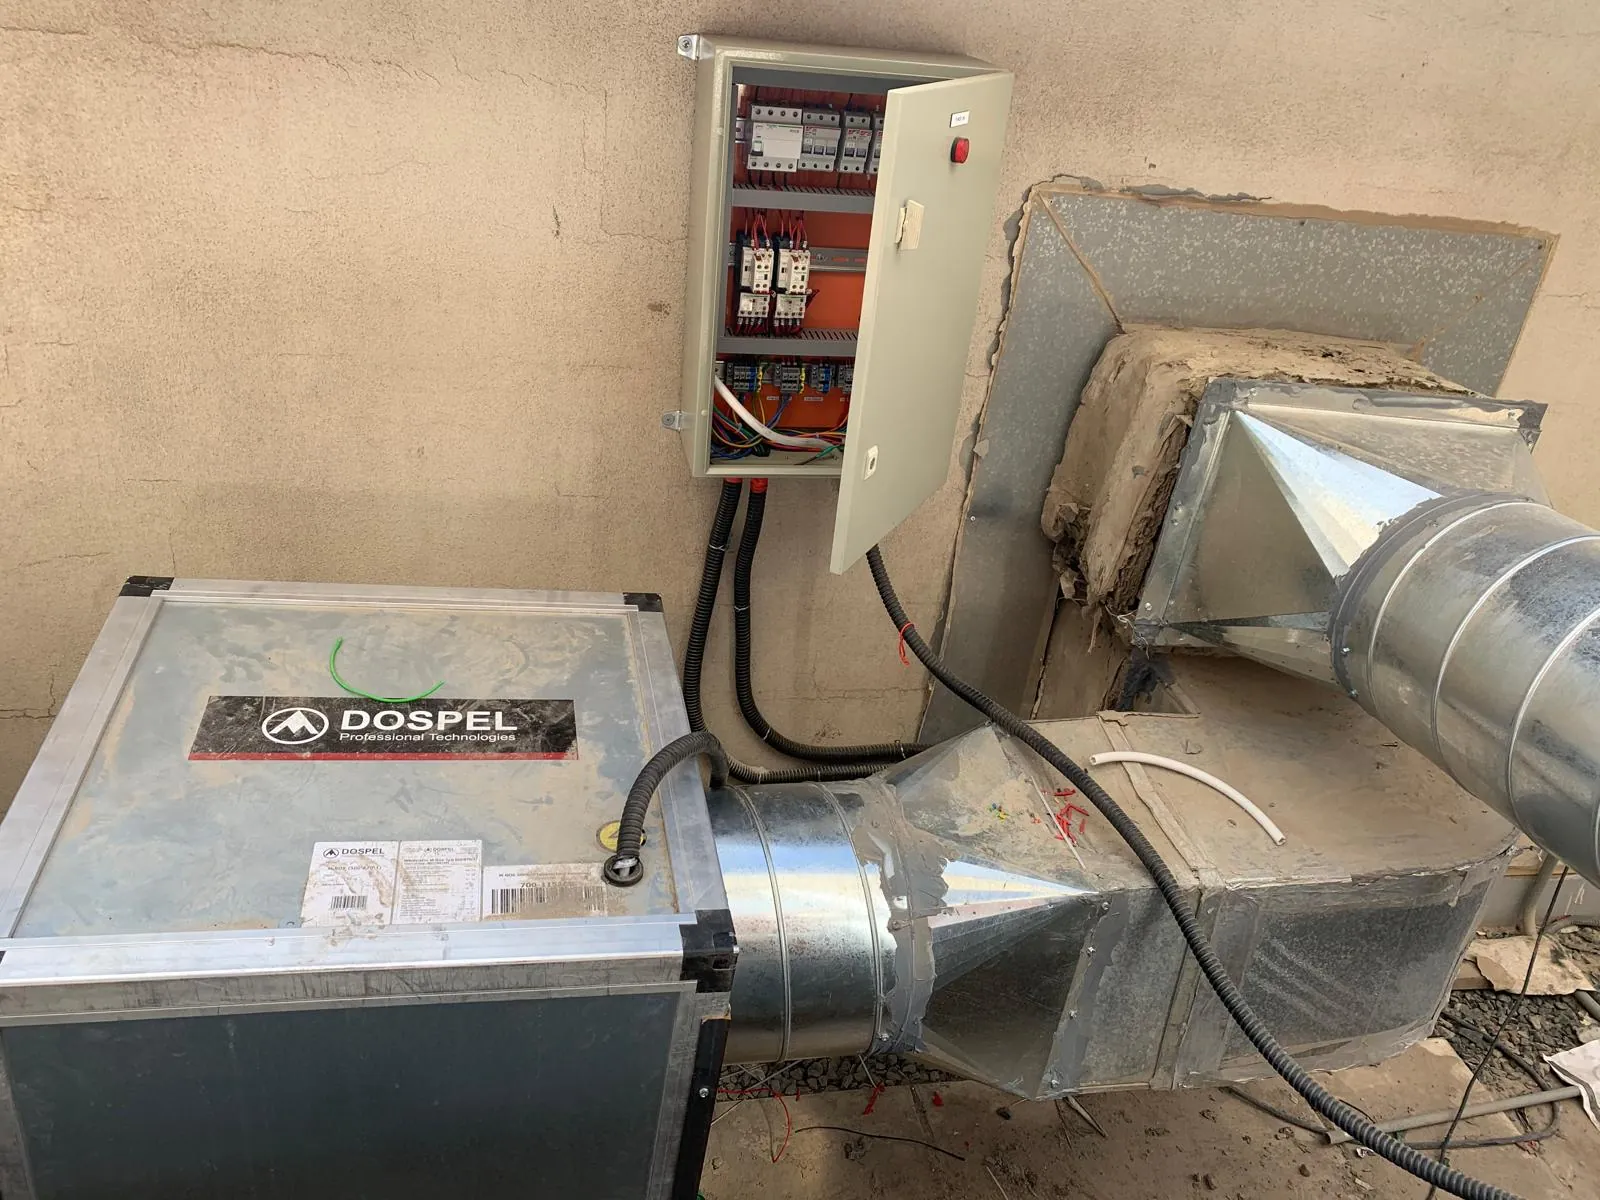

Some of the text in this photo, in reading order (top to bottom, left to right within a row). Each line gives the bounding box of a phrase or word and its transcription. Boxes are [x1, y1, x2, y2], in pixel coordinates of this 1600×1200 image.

[340, 709, 518, 731] DOSPEL
[339, 732, 516, 743] Professional Technologies
[341, 847, 385, 855] DOSPEL
